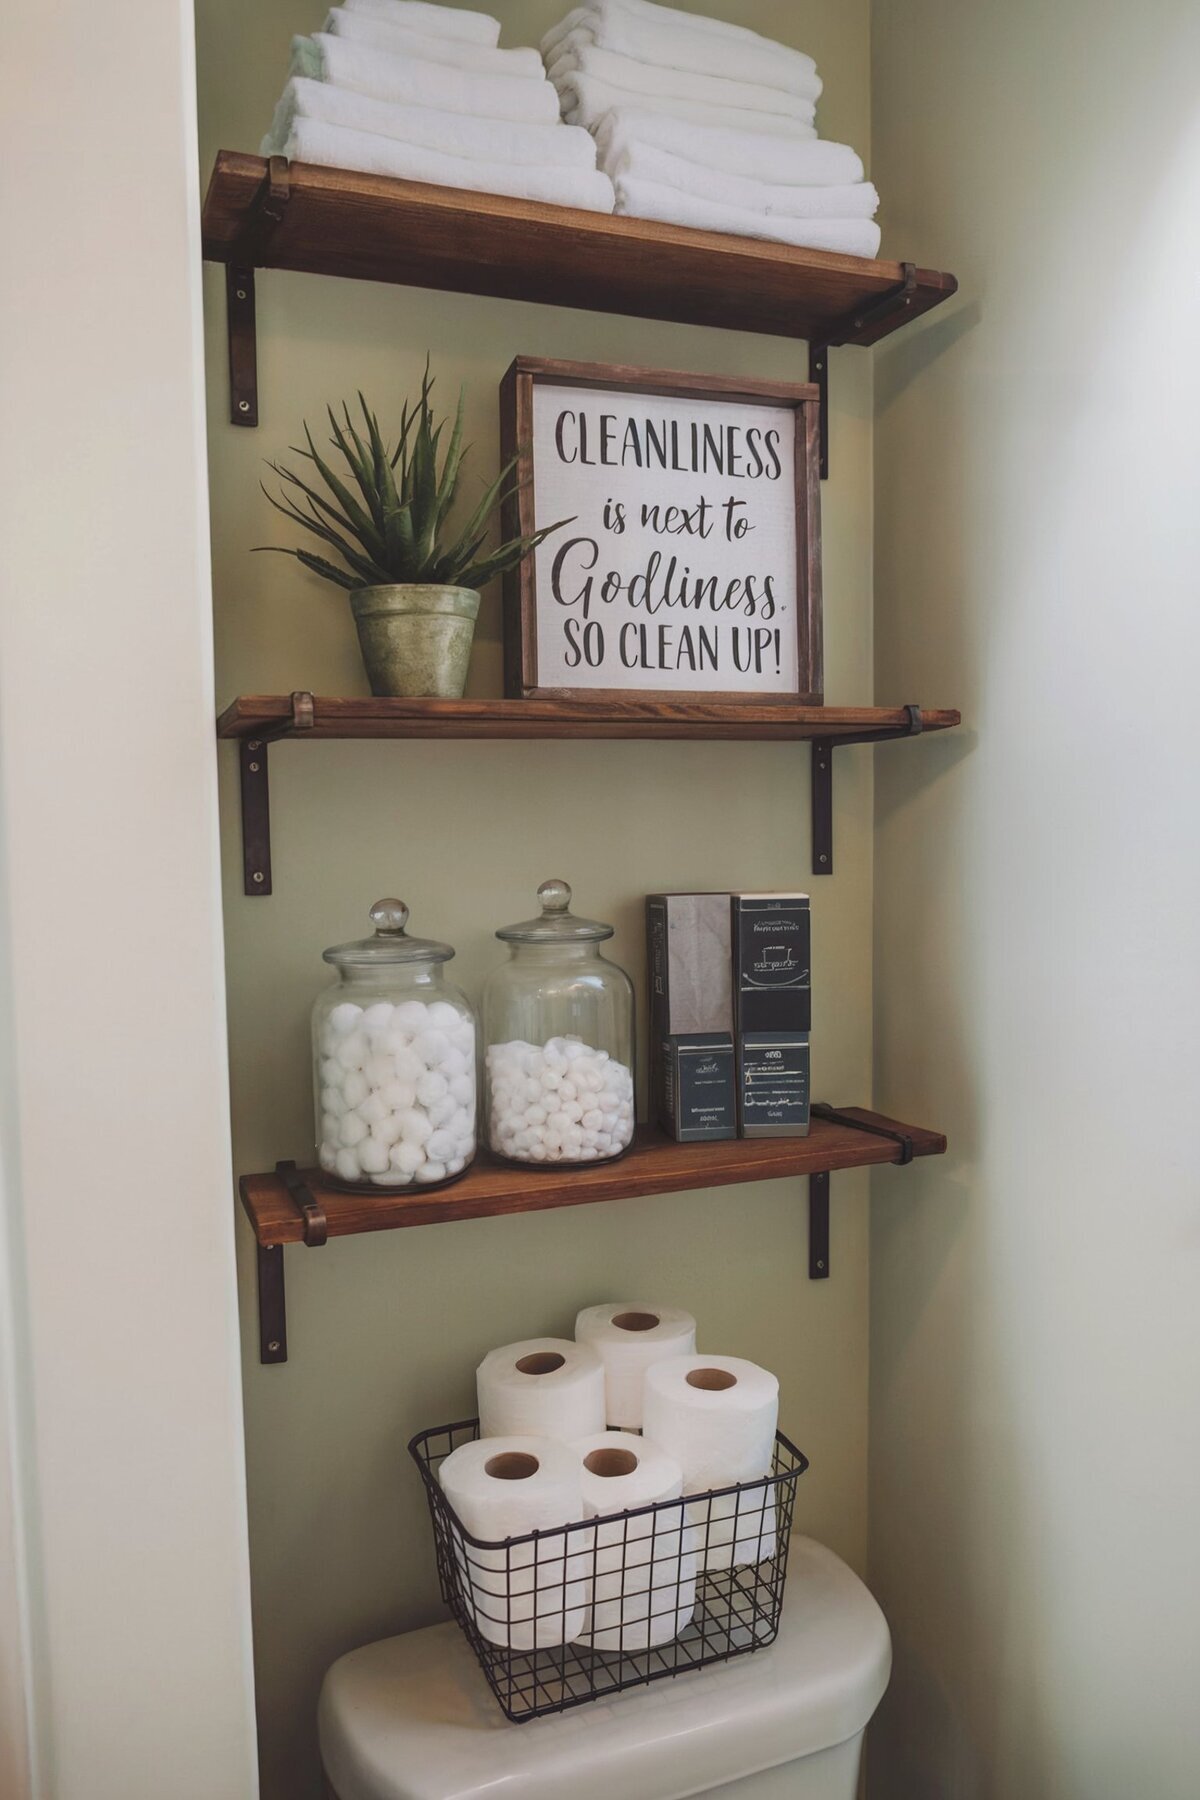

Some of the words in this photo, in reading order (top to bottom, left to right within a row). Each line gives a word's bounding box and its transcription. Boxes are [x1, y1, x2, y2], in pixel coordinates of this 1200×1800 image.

[555, 410, 782, 480] CLEANLINESS
[603, 498, 627, 534] is
[641, 495, 714, 539] next
[722, 495, 756, 542] to
[551, 537, 787, 620] Godliness.
[563, 618, 605, 667] SO
[619, 621, 719, 671] CLEAN
[731, 627, 781, 675] UP!
